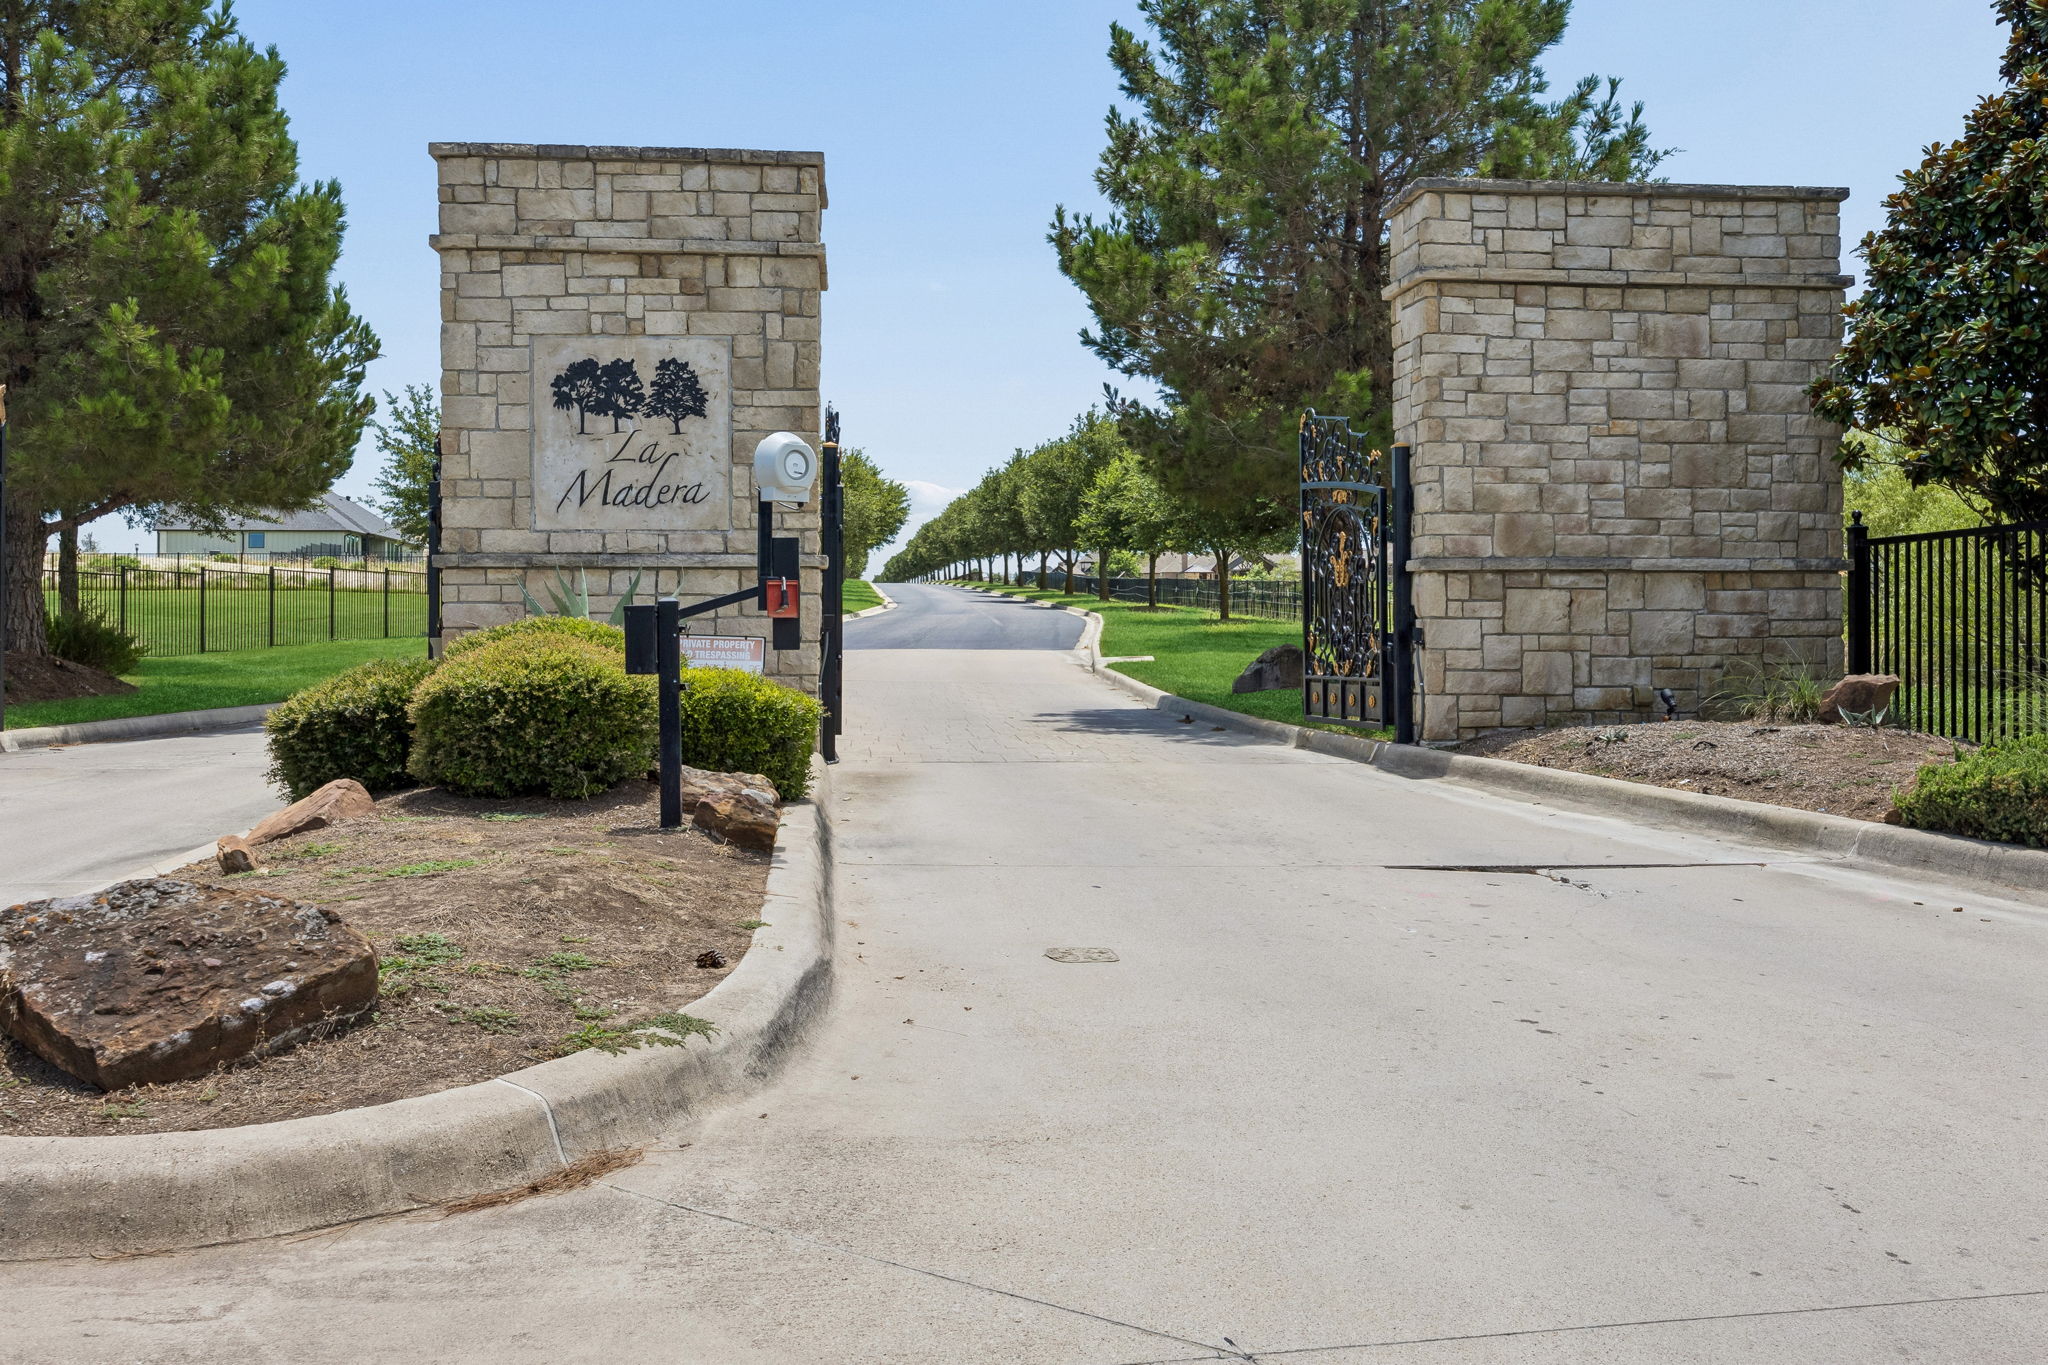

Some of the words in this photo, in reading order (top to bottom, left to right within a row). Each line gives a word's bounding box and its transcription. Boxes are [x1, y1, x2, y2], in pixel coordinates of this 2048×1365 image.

[606, 429, 667, 464] La
[556, 453, 711, 513] Madera
[695, 651, 750, 660] TRESPASSING
[713, 641, 755, 649] PROPERTY
